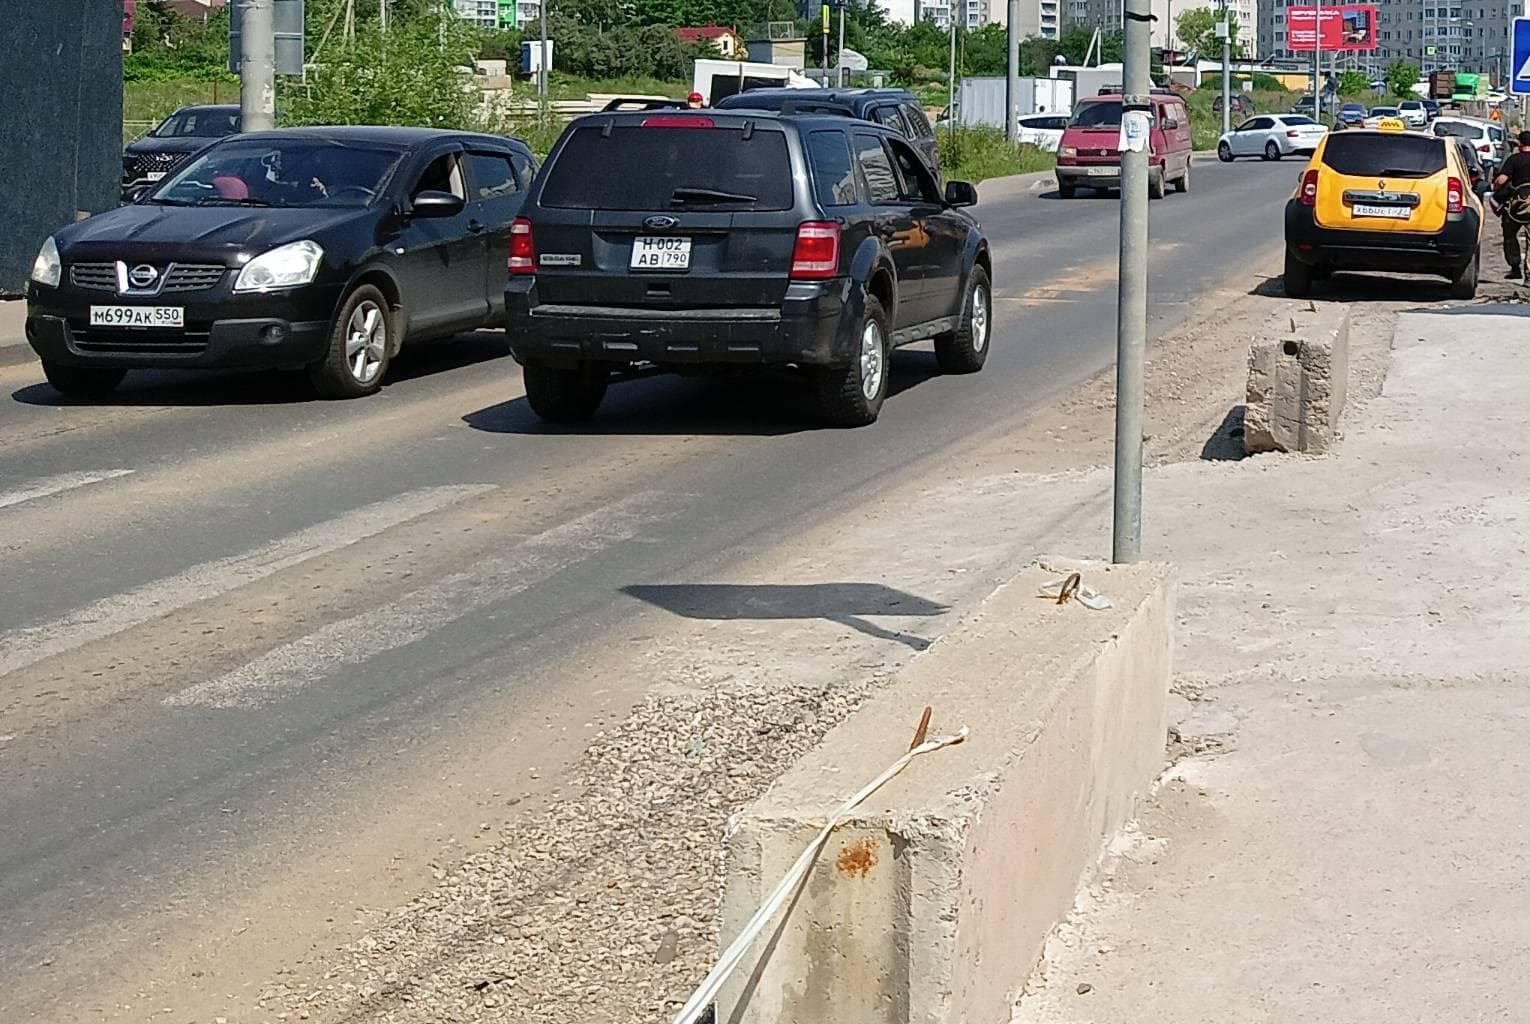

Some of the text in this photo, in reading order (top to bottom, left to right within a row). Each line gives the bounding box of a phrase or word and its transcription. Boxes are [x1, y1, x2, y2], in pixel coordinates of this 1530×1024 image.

[666, 254, 686, 263] 790
[94, 308, 179, 324] М699АК 550
